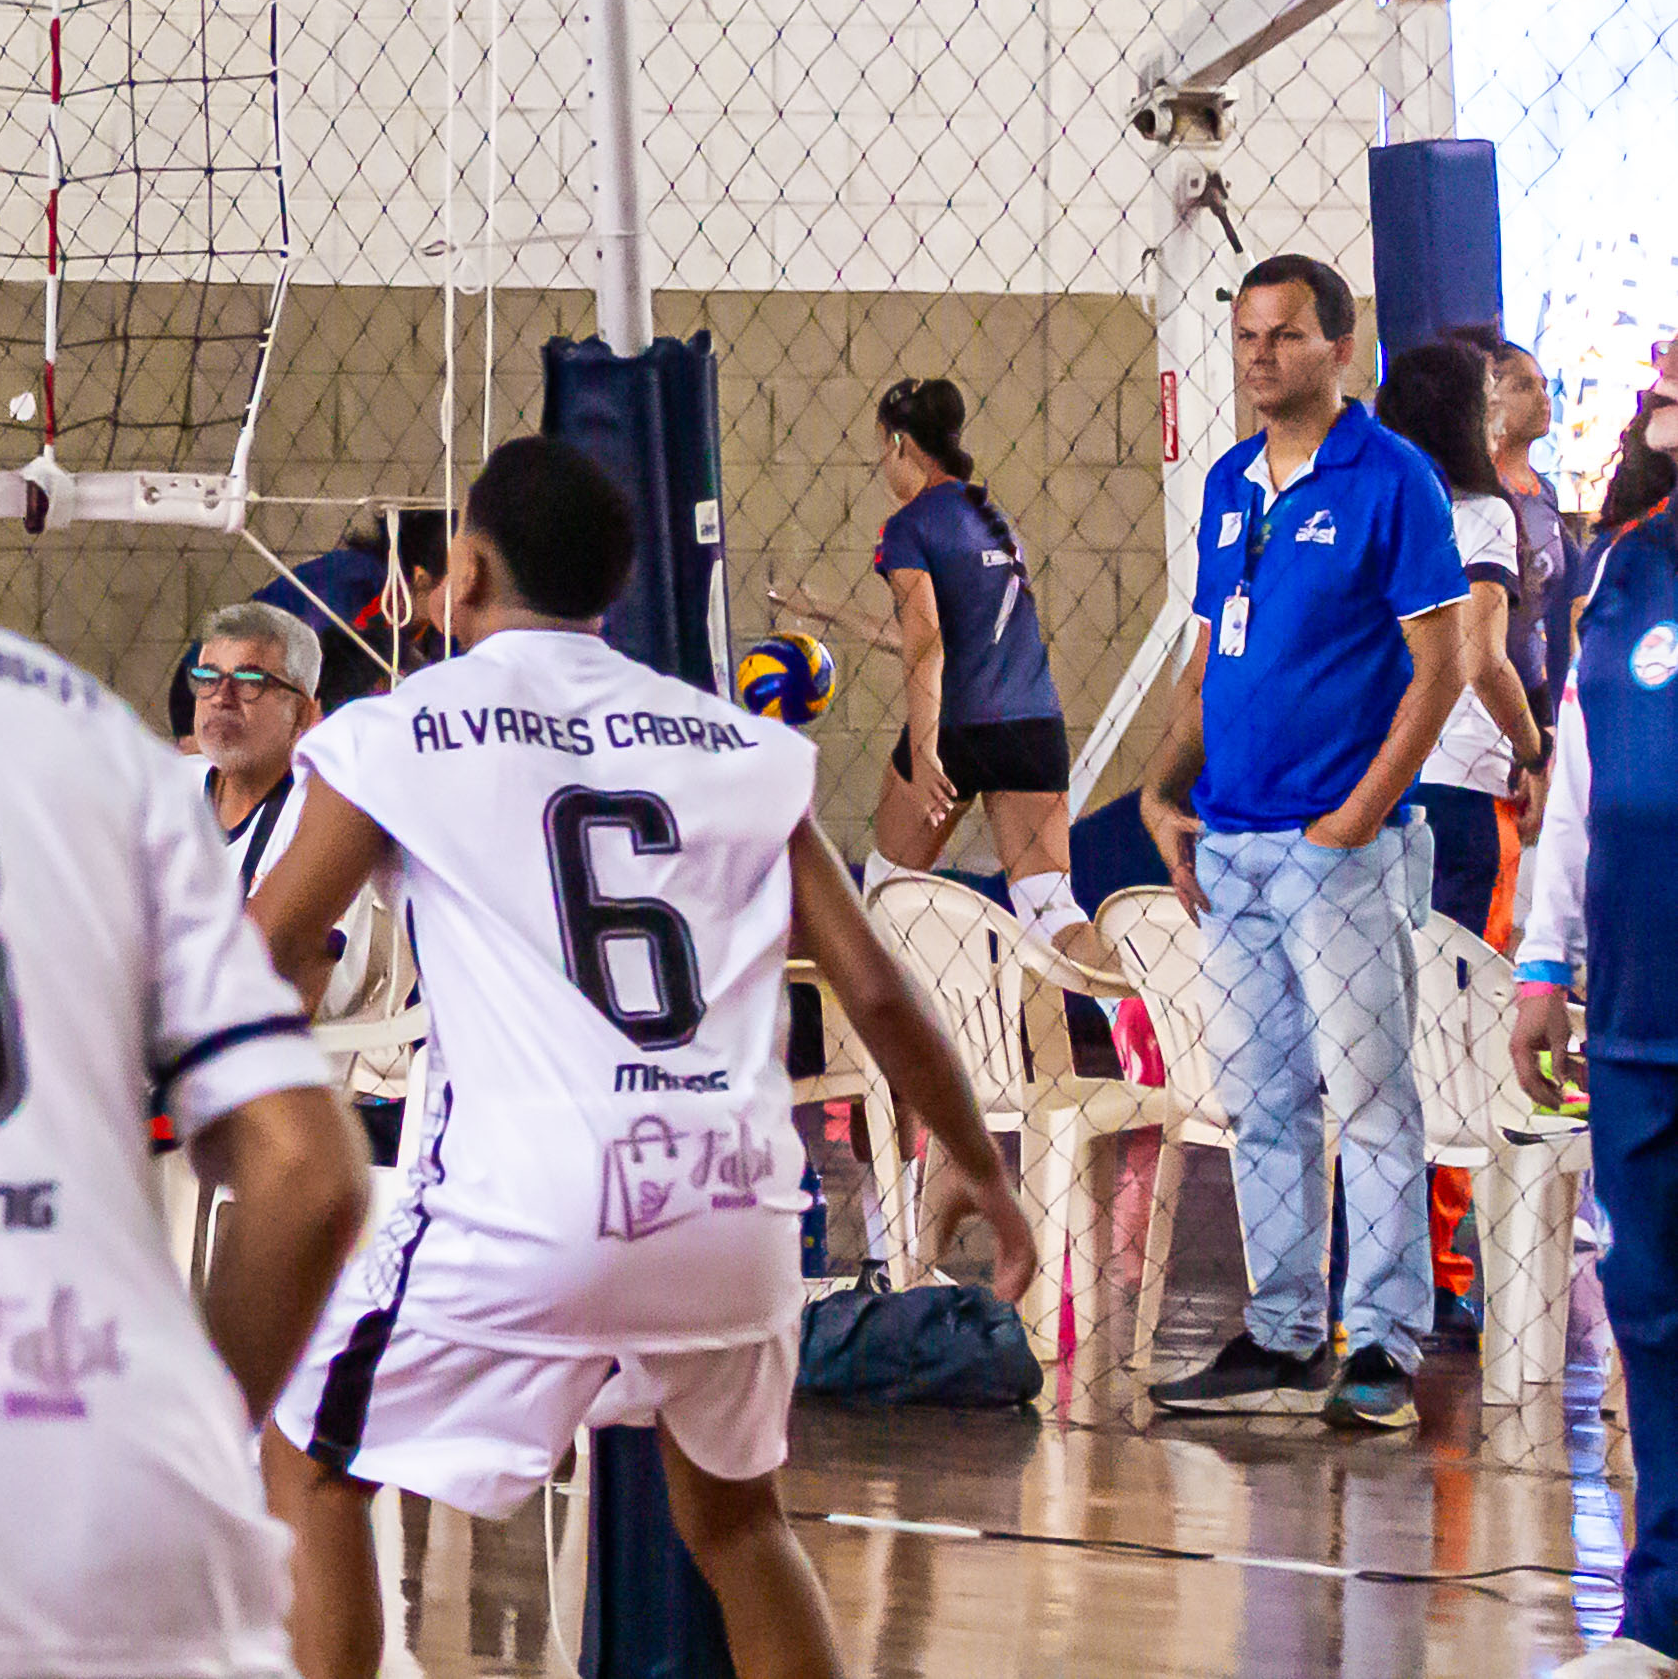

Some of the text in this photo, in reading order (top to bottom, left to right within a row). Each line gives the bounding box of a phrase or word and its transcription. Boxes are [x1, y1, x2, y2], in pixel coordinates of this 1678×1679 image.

[412, 706, 759, 756] ÁLVARES CABRAL
[543, 784, 707, 1052] 6
